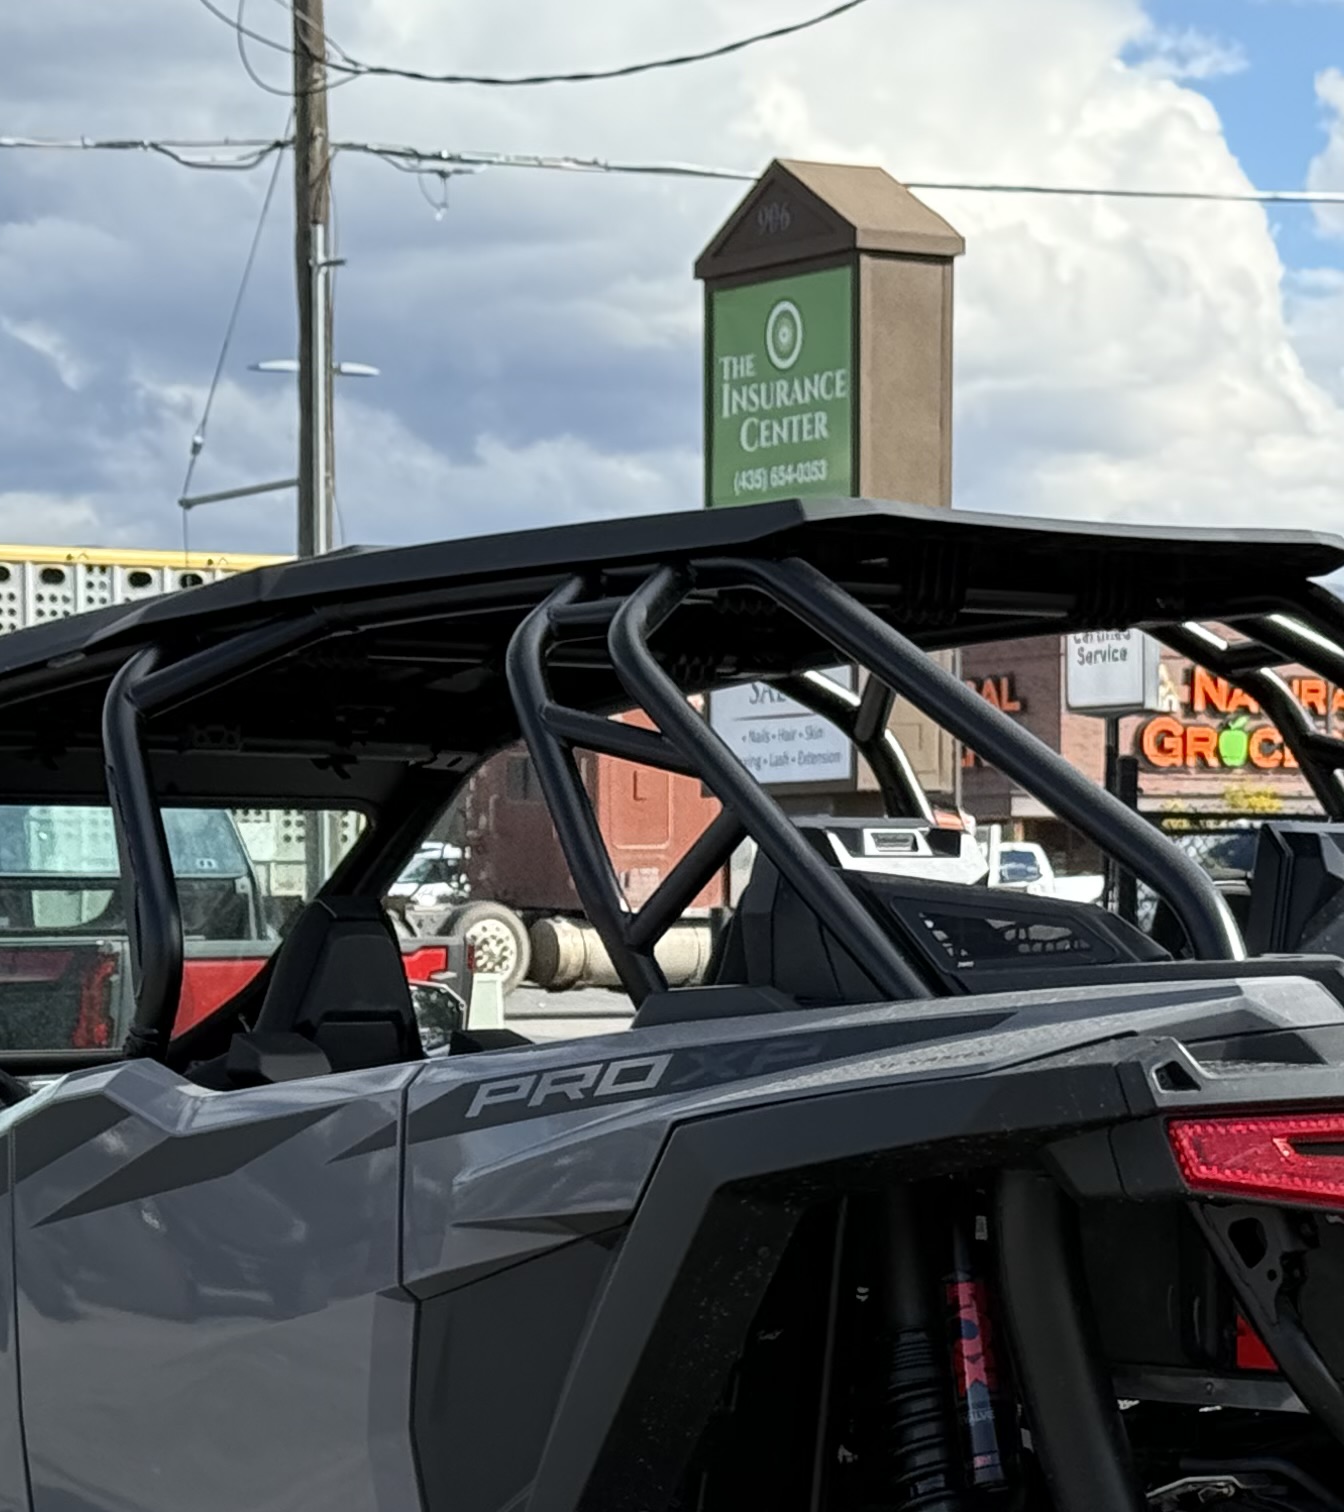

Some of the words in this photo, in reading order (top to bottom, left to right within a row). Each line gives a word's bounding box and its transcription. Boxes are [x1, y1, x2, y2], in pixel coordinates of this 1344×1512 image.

[719, 353, 757, 381] THE
[720, 368, 848, 418] INSURANCE
[739, 410, 829, 452] CENTER
[1077, 643, 1128, 666] Service
[464, 1053, 675, 1119] PRO
